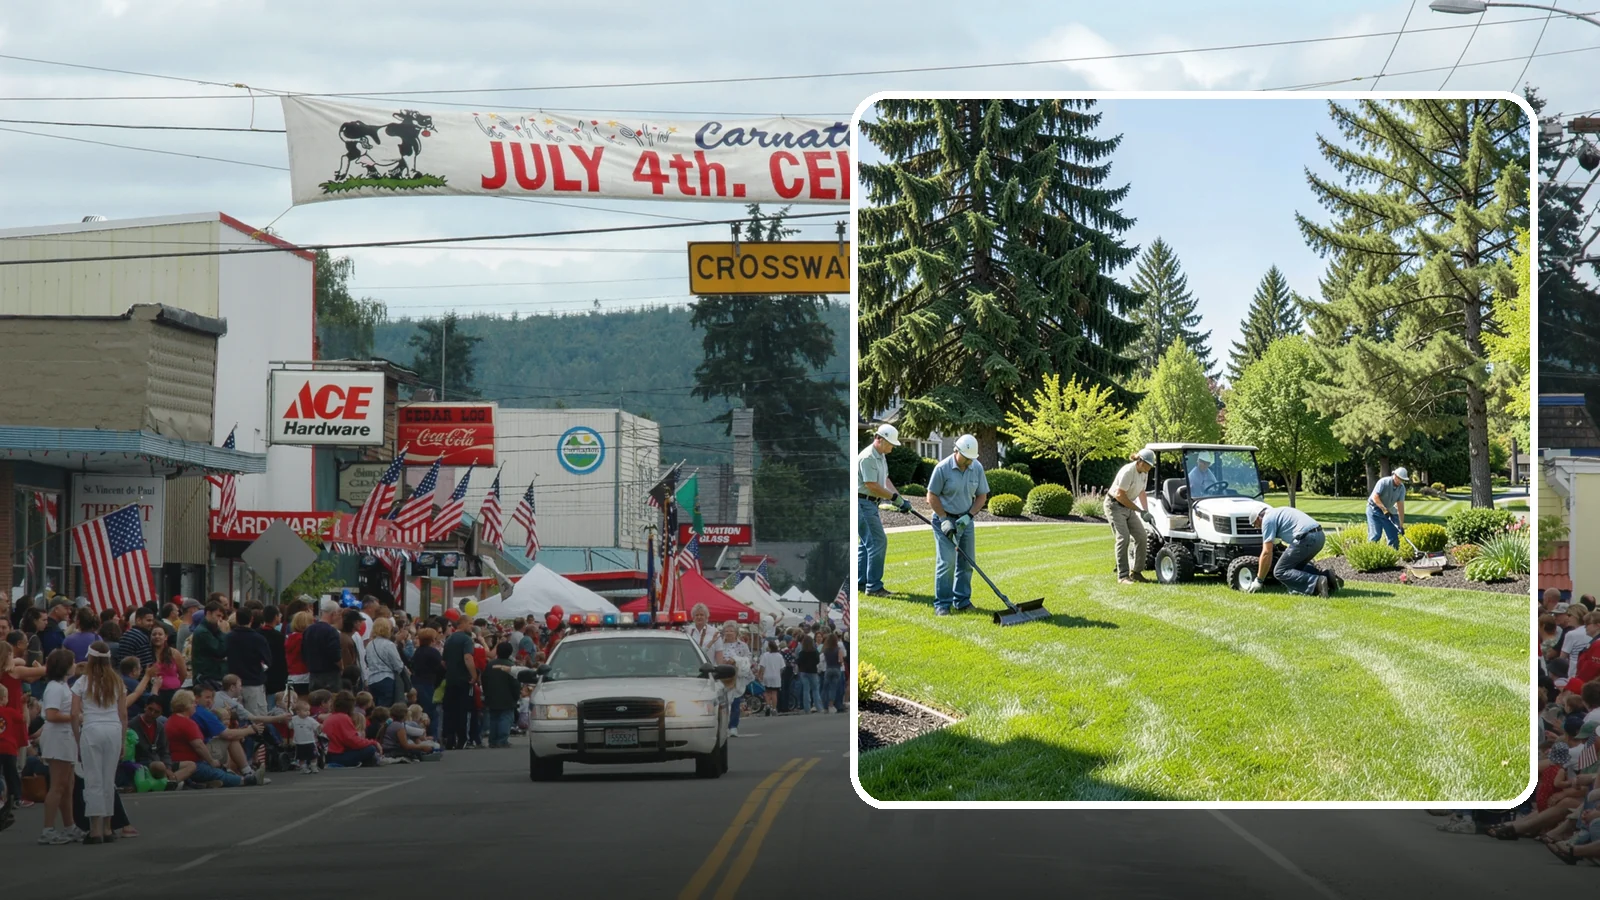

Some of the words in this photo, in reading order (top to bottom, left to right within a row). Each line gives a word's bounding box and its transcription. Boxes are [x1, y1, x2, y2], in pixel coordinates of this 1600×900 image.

[695, 121, 849, 150] Carnat
[481, 141, 604, 192] JULY
[632, 150, 746, 197] 4th.
[697, 254, 849, 280] CROSSWA
[283, 380, 373, 420] ACE
[405, 410, 452, 421] CEDAR
[283, 421, 370, 436] Hardware
[353, 467, 386, 481] Simpl
[96, 485, 124, 494] Vincent
[126, 486, 136, 494] de
[138, 486, 155, 495] Paul
[81, 503, 153, 522] THRT
[688, 526, 741, 535] CRNATION
[700, 535, 730, 543] GLASS
